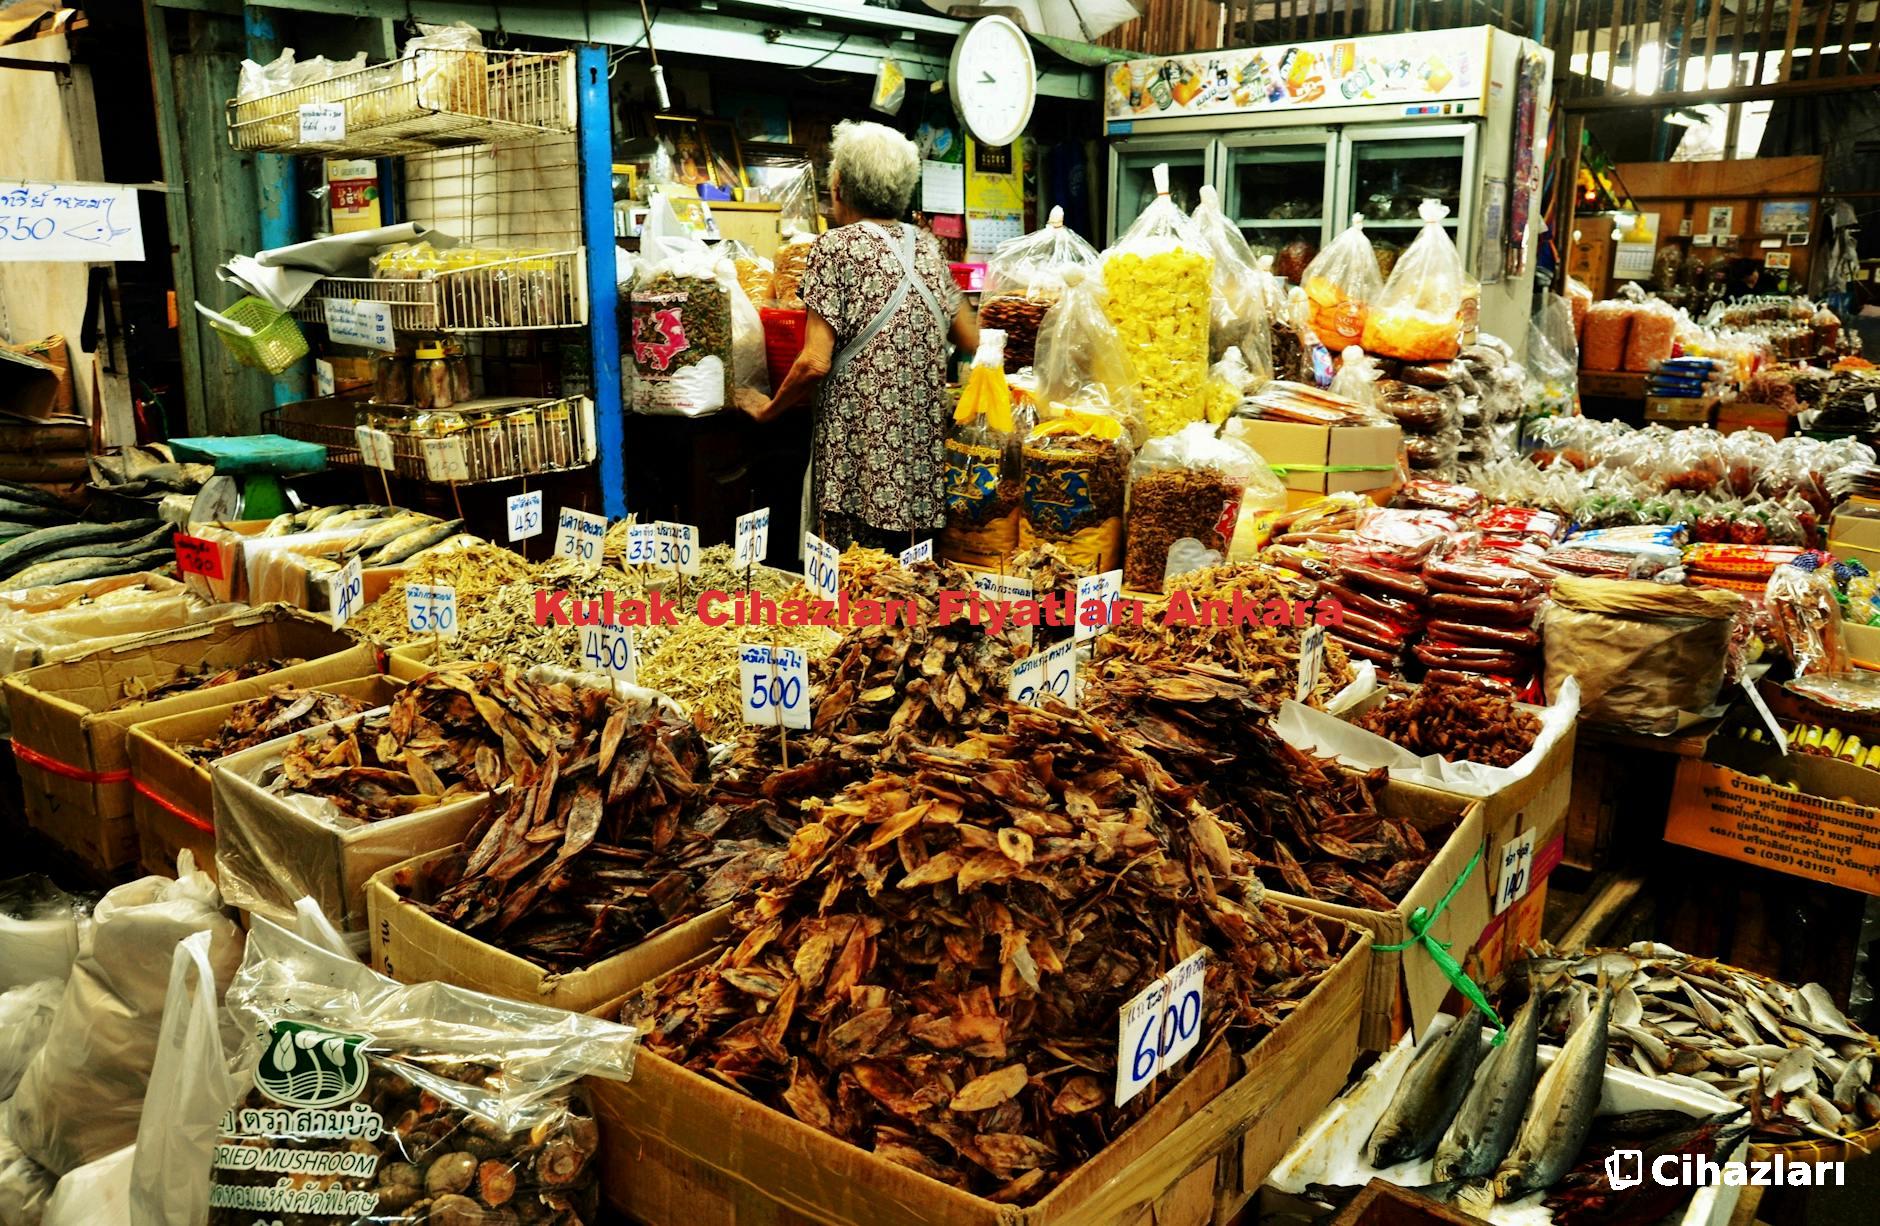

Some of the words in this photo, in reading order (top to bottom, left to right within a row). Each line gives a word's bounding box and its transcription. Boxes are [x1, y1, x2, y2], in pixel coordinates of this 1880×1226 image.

[514, 511, 538, 532] 450
[564, 535, 594, 560] 350
[628, 540, 656, 560] 35
[659, 541, 691, 565] 300
[809, 555, 837, 594] 400
[337, 577, 361, 620] 400
[410, 604, 453, 631] 350
[586, 630, 628, 671] 450
[750, 673, 801, 710] 500
[1760, 849, 1794, 866] (039)
[1797, 859, 1837, 876] 431151
[1132, 990, 1201, 1082] 600
[260, 1149, 375, 1175] MUSHROOM
[211, 1179, 379, 1214] ดหอมแห้งคัดพิเศษ
